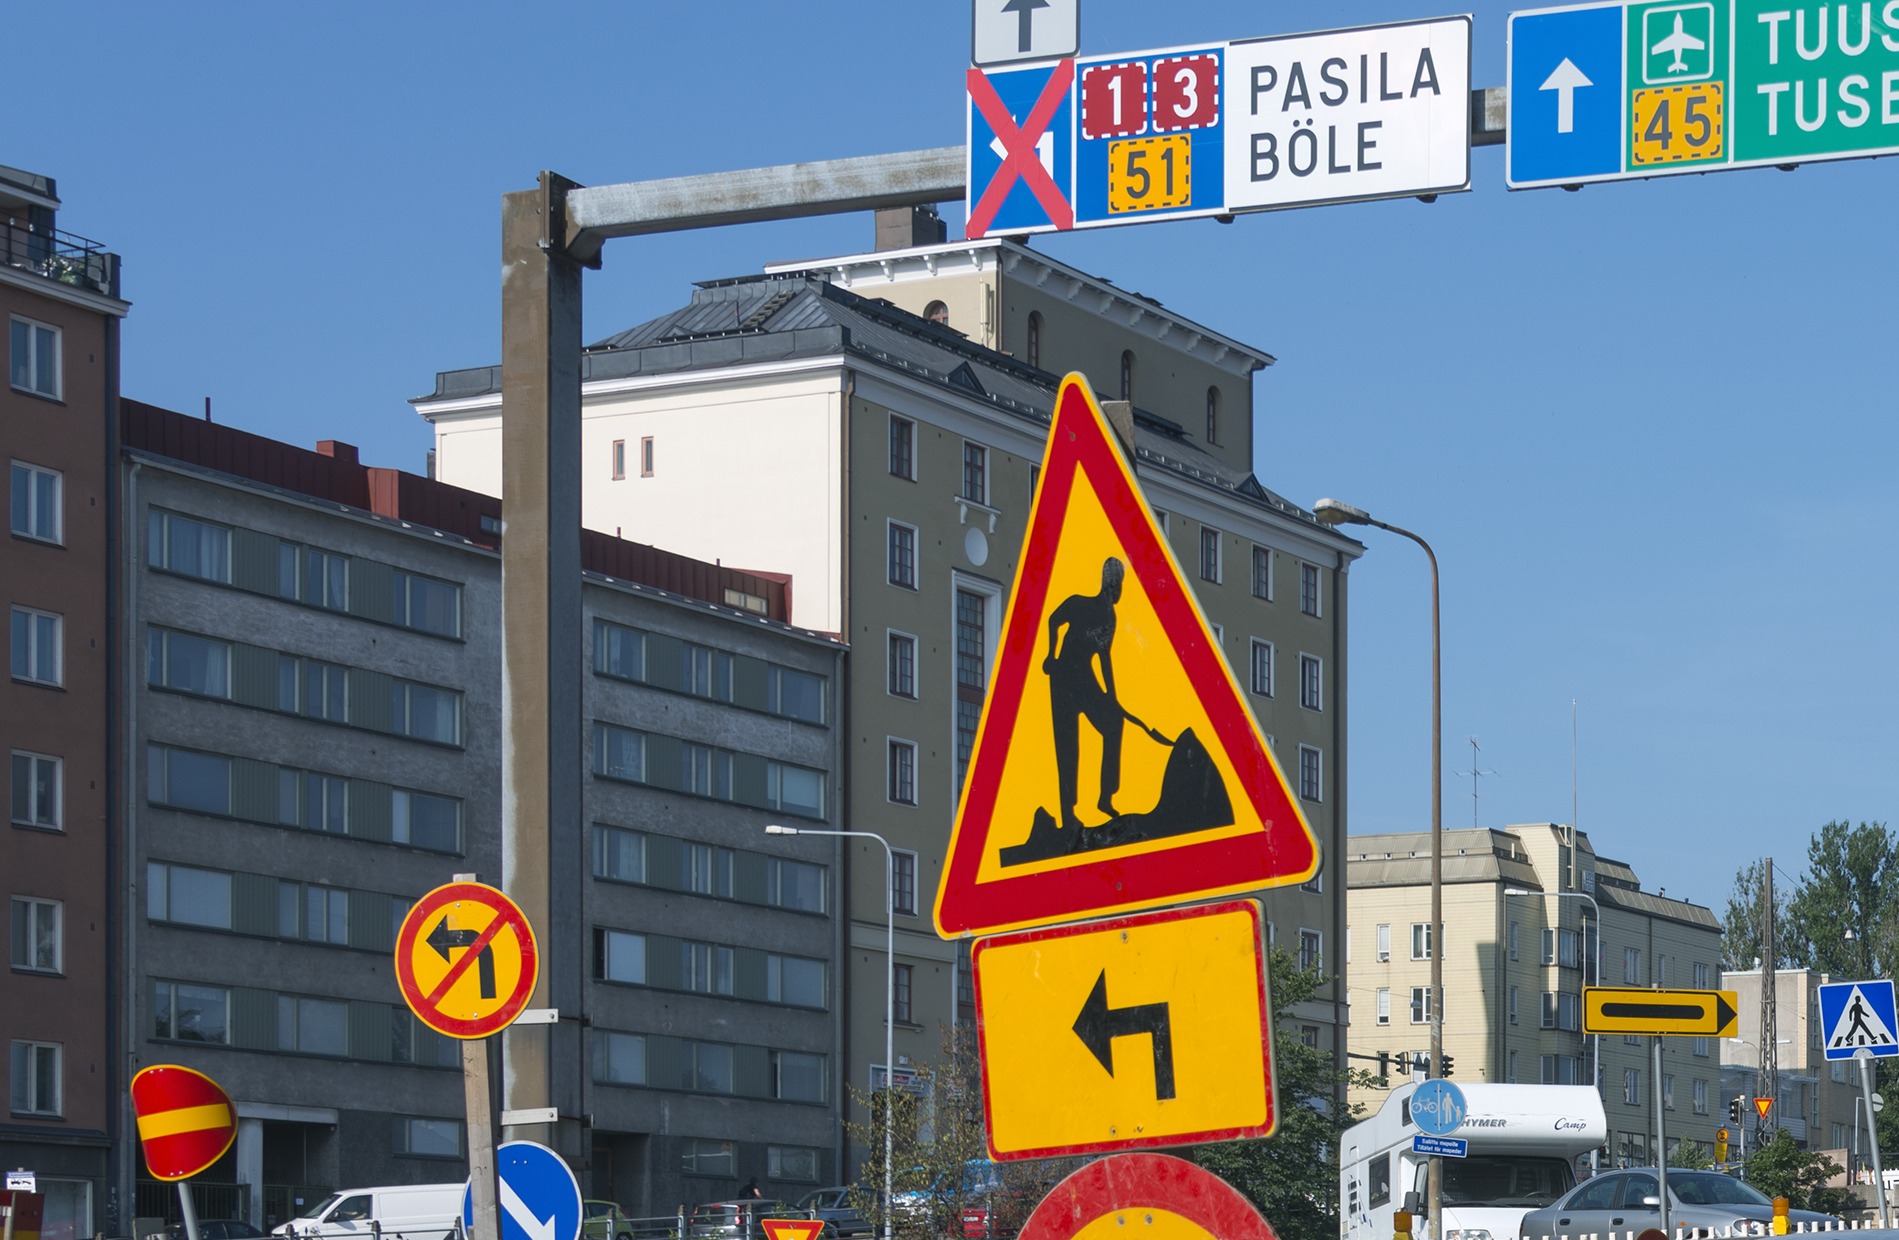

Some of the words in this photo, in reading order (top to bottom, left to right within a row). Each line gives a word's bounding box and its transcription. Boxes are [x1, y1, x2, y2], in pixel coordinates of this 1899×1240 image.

[1107, 75, 1122, 126] 1
[1172, 67, 1199, 119] 3
[1250, 47, 1441, 116] PASILA
[1250, 119, 1383, 183] BÖLE
[1643, 96, 1712, 151] 45
[1125, 146, 1175, 200] 51
[1460, 1118, 1507, 1128] HYMER
[1554, 1117, 1587, 1132] Camp
